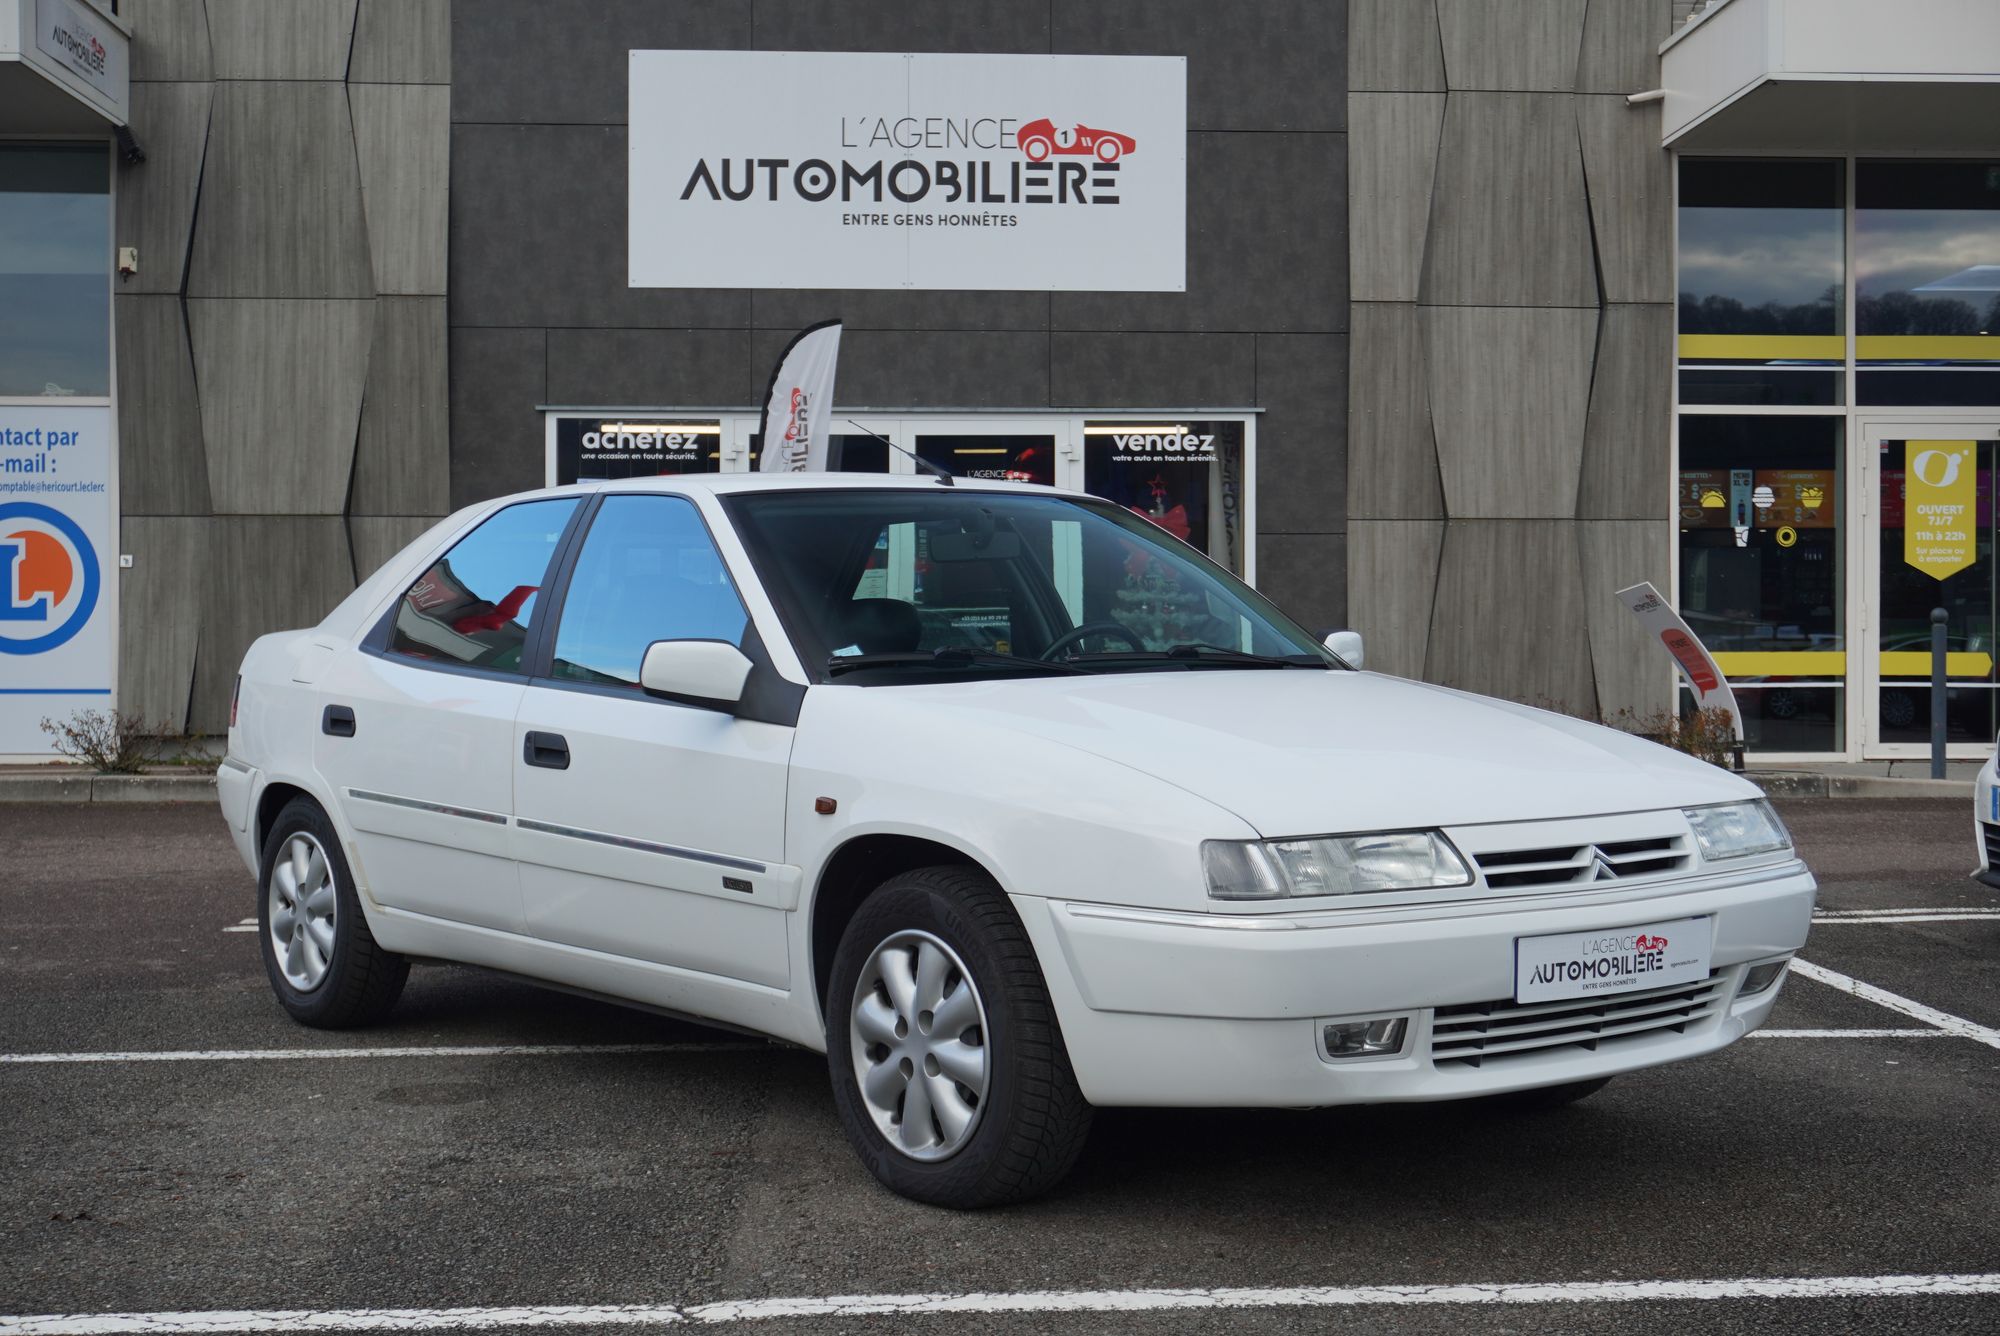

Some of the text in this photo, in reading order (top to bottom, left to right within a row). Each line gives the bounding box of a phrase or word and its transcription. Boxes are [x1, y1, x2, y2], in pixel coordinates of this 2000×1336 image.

[842, 117, 1018, 149] L'AGENCE
[1060, 130, 1068, 144] 1
[680, 158, 1120, 204] AUTOMOBILIERE
[842, 211, 1017, 227] ENTRE GENS HONNÊTES
[47, 431, 79, 451] par
[582, 422, 698, 449] achetez
[1113, 424, 1215, 451] vendez
[597, 451, 629, 460] occasion
[643, 452, 664, 460] toute
[1112, 454, 1132, 462] votre
[1133, 454, 1152, 462] auto
[1164, 454, 1185, 462] toute
[1916, 504, 1965, 515] OUVERT
[1582, 935, 1637, 956] L'AGENCE
[1530, 950, 1664, 985] AUTOMOBILIERE
[1582, 982, 1598, 990] ENTRE
[1599, 980, 1612, 989] GENS
